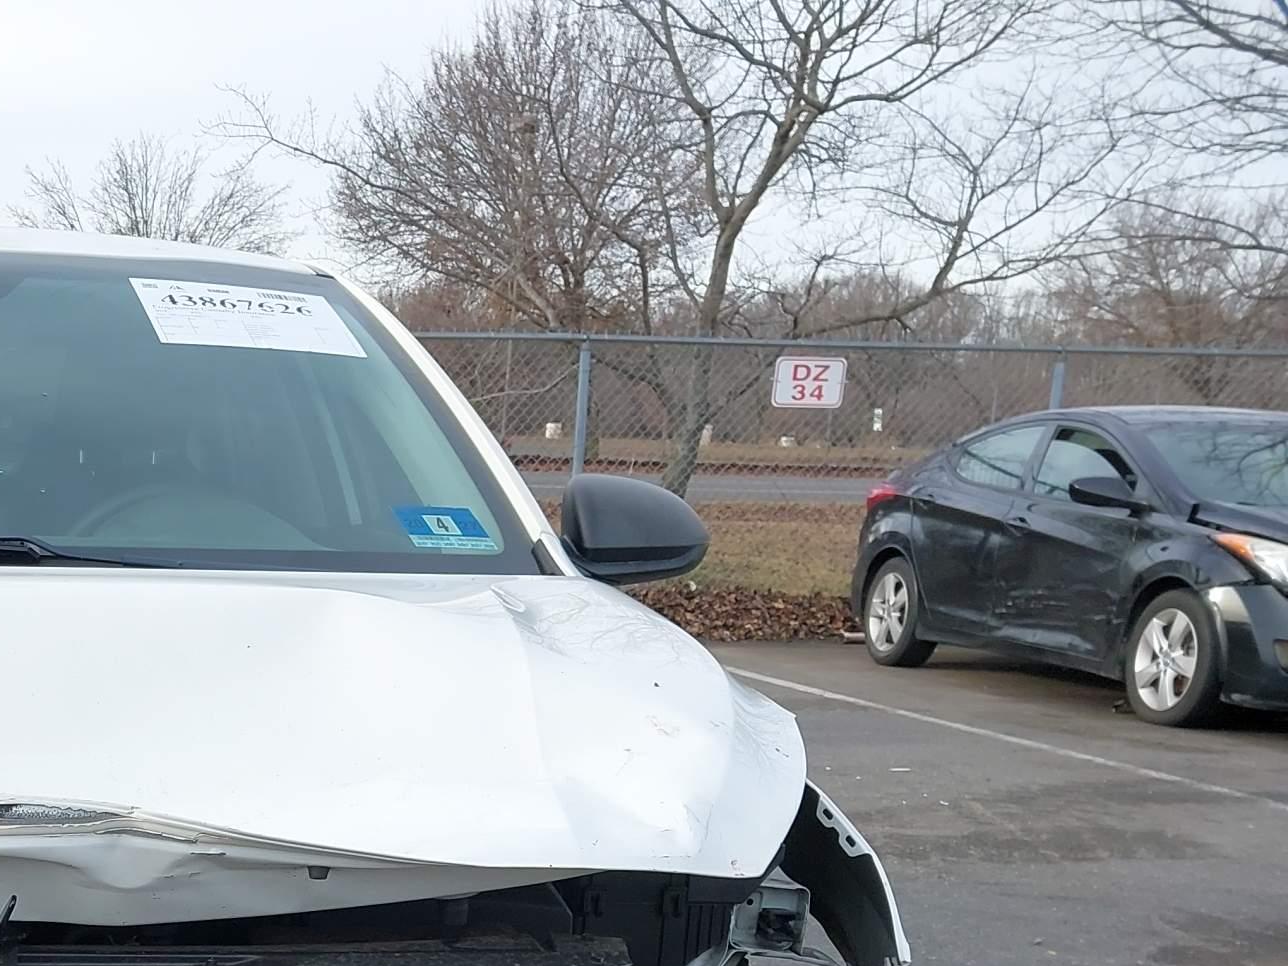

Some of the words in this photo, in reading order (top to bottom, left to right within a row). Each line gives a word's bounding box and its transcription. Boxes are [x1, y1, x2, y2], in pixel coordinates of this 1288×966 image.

[160, 293, 313, 317] 43867626
[792, 364, 831, 382] DZ
[791, 383, 824, 401] 34
[436, 517, 450, 533] 4
